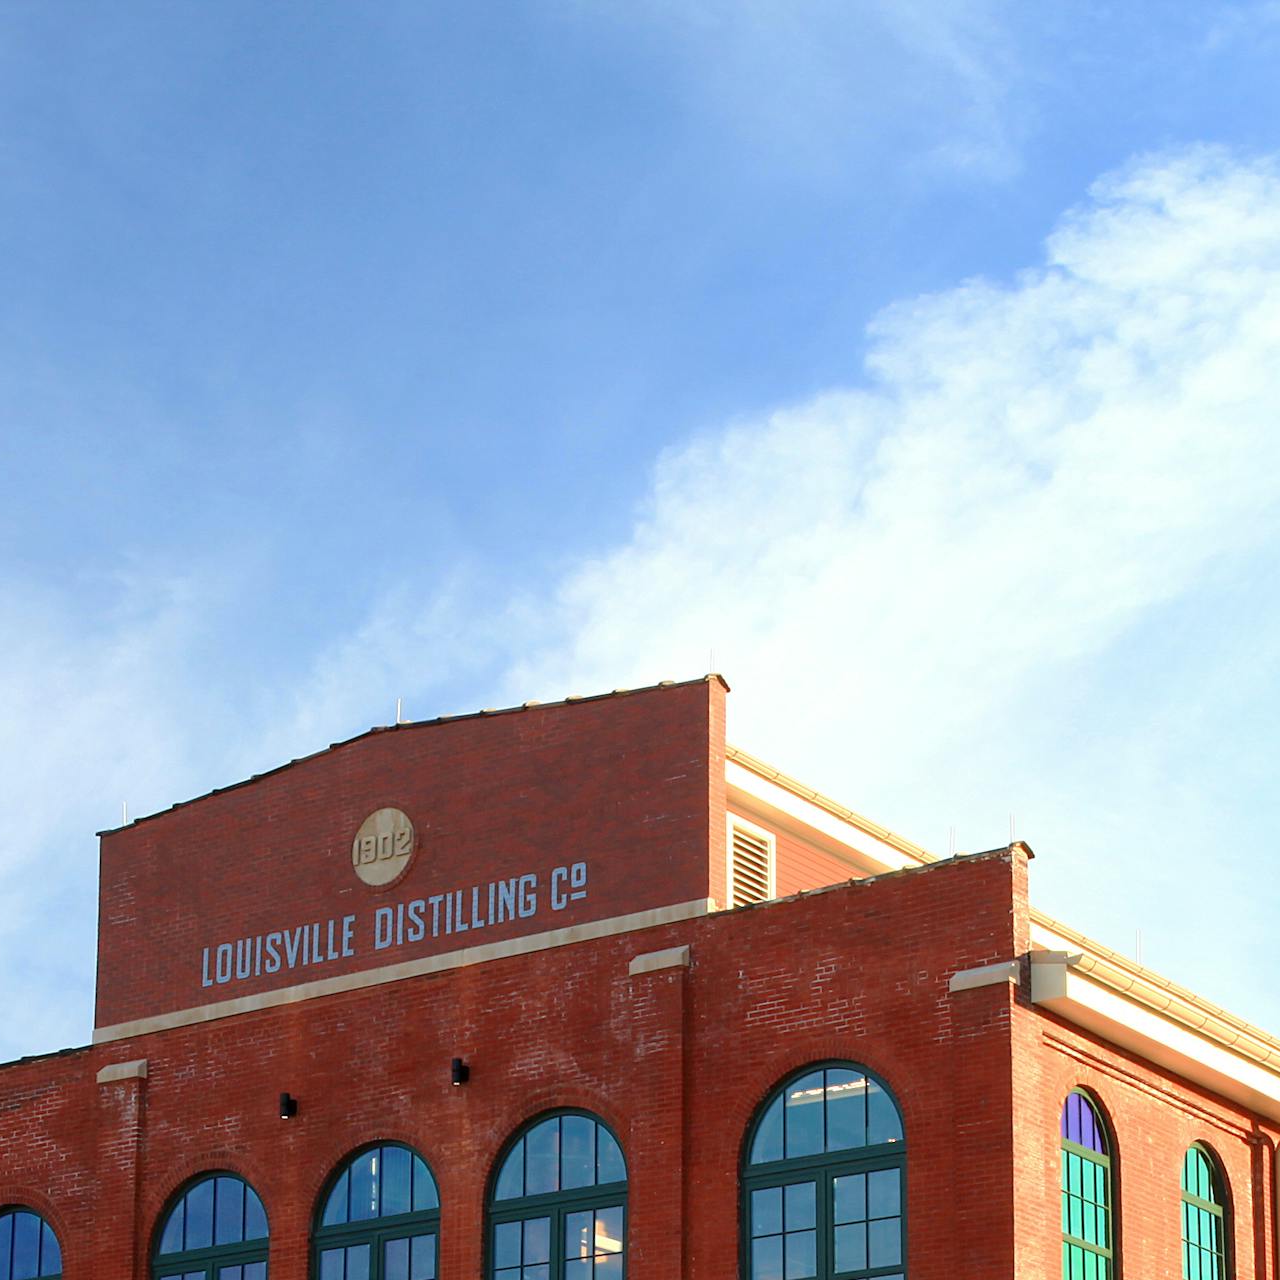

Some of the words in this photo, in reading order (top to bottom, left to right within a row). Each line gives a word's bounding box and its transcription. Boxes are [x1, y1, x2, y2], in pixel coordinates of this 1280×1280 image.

[352, 827, 412, 867] 1902
[201, 914, 355, 987] LOUISVILLE
[374, 873, 537, 950] DISTILLING
